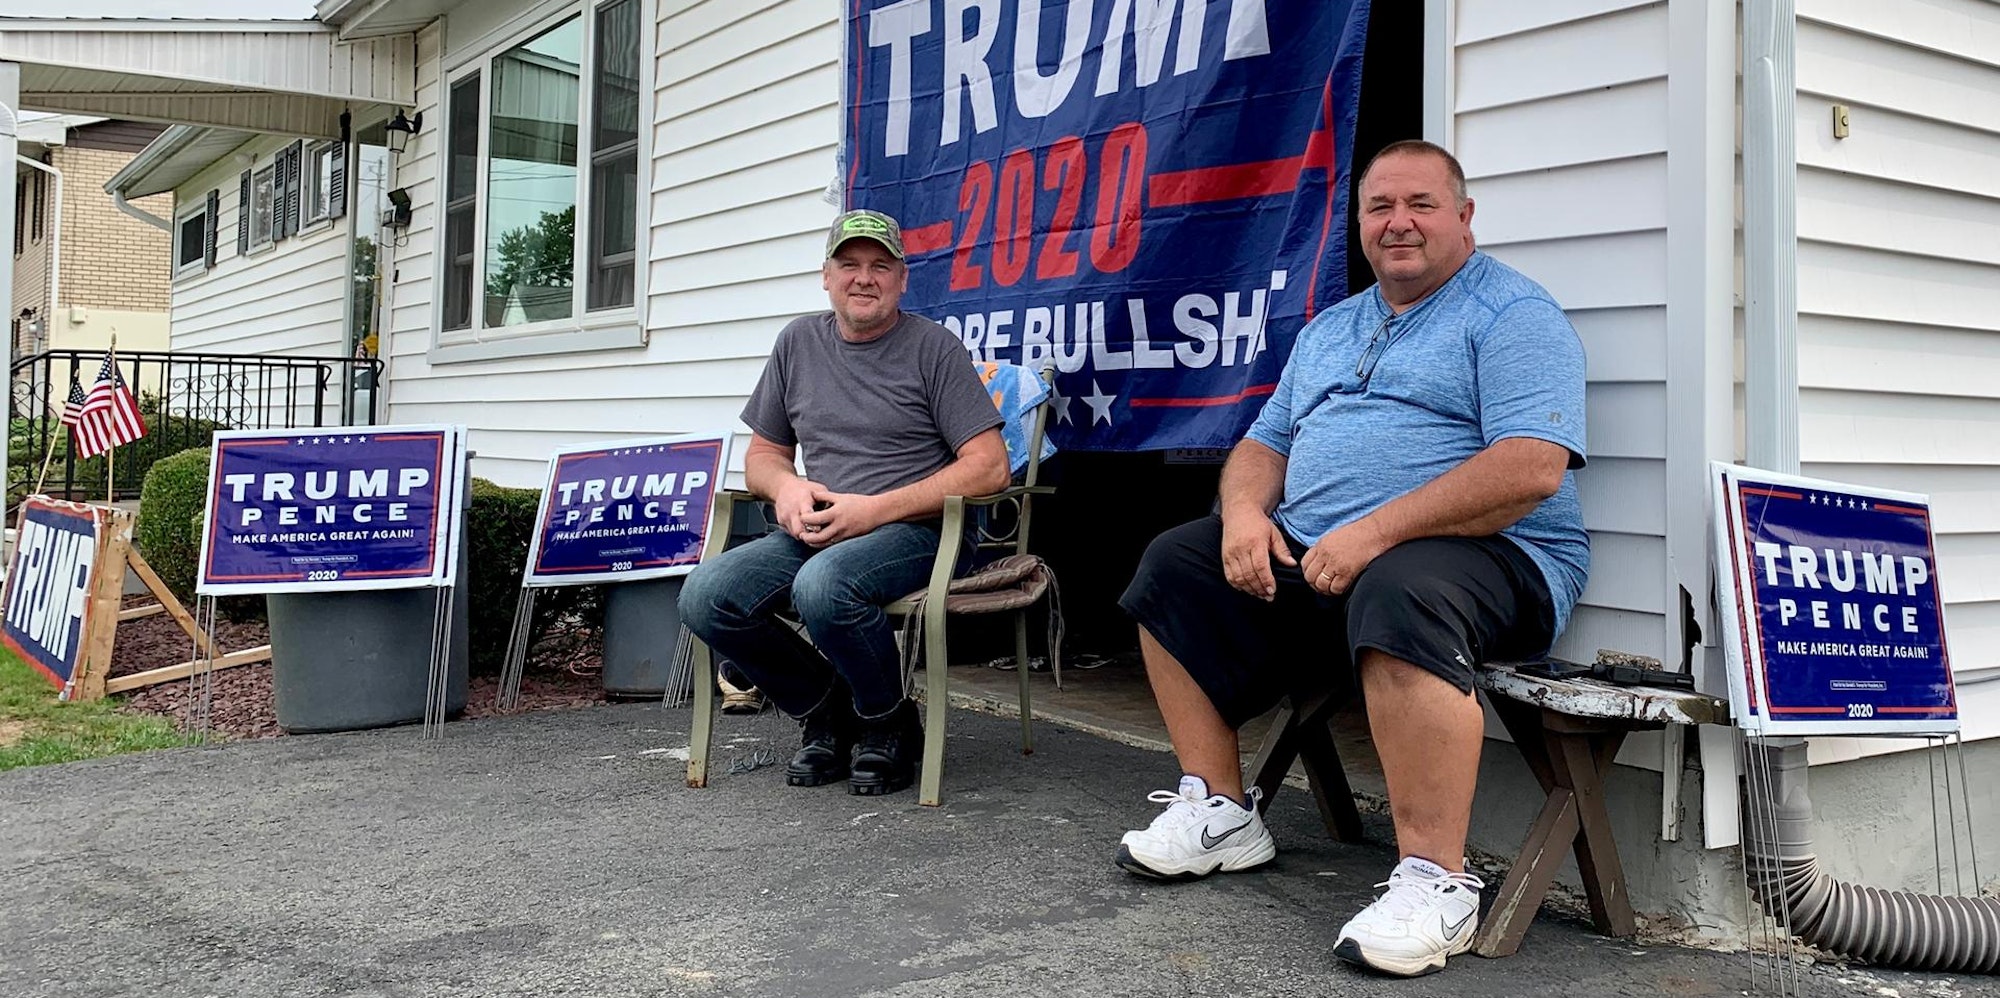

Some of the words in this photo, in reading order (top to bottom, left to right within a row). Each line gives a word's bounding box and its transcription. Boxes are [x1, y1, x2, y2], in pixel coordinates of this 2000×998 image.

[949, 121, 1148, 291] 2020
[1022, 270, 1287, 374] BULLSH
[225, 468, 430, 502] TRUMP
[558, 471, 708, 506] TRUMP
[241, 502, 409, 526] PENCE
[565, 500, 688, 526] PENCE
[232, 533, 267, 544] MAKE
[270, 532, 326, 543] AMERICA
[330, 531, 368, 541] GREAT
[372, 529, 415, 539] AGAIN!
[556, 531, 580, 540] MAKE
[582, 528, 626, 538] AMERICA
[627, 525, 656, 535] GREAT
[656, 523, 690, 533] AGAIN!
[307, 570, 338, 580] 2020
[611, 561, 633, 571] 2020
[1754, 541, 1928, 596] TRUMP
[6, 519, 95, 662] TRUMP
[1779, 598, 1919, 633] PENCE
[1777, 640, 1808, 655] MAKE
[1810, 642, 1857, 657] AMERICA
[1858, 644, 1891, 658] GREAT
[1893, 645, 1929, 659] AGAIN!
[1848, 703, 1874, 718] 2020
